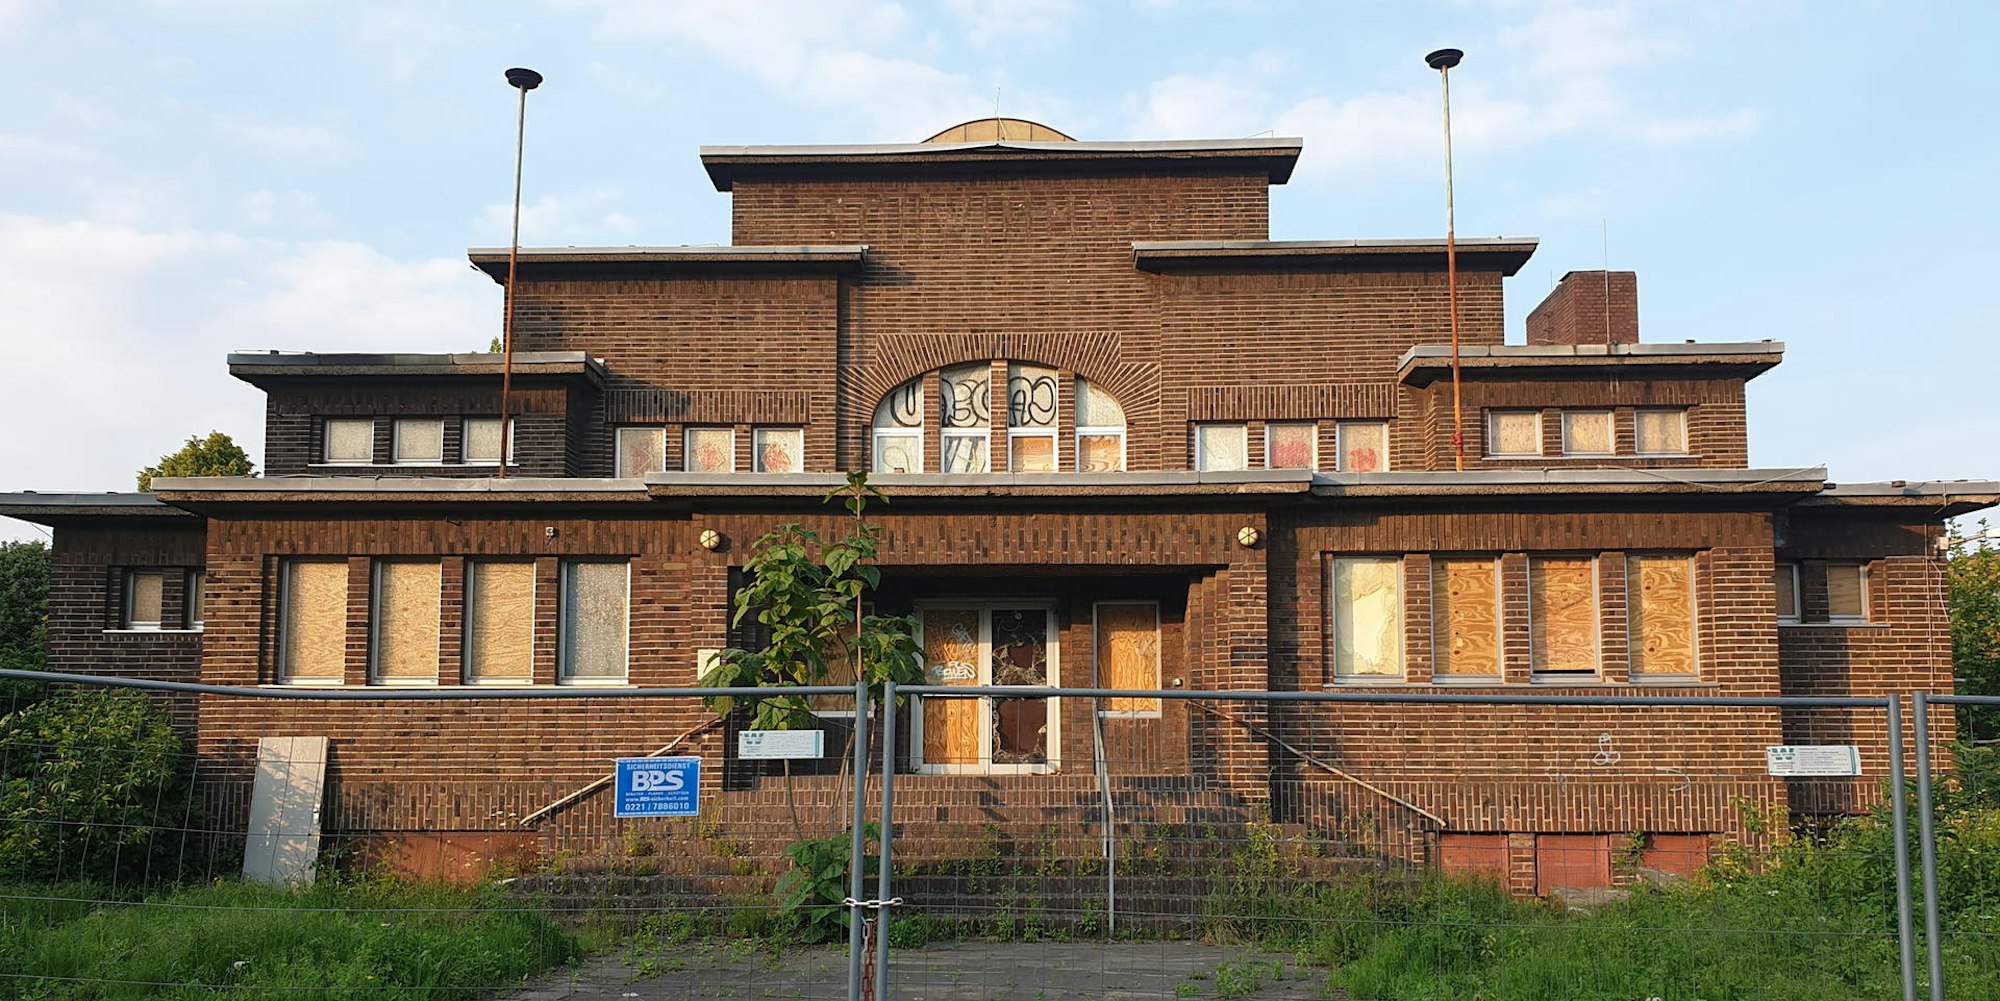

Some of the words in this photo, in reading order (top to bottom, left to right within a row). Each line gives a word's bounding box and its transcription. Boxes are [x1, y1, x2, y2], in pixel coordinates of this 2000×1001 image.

[626, 762, 691, 770] SICHERHEITSDIENST
[631, 770, 684, 792] BPS
[625, 803, 645, 811] 0221
